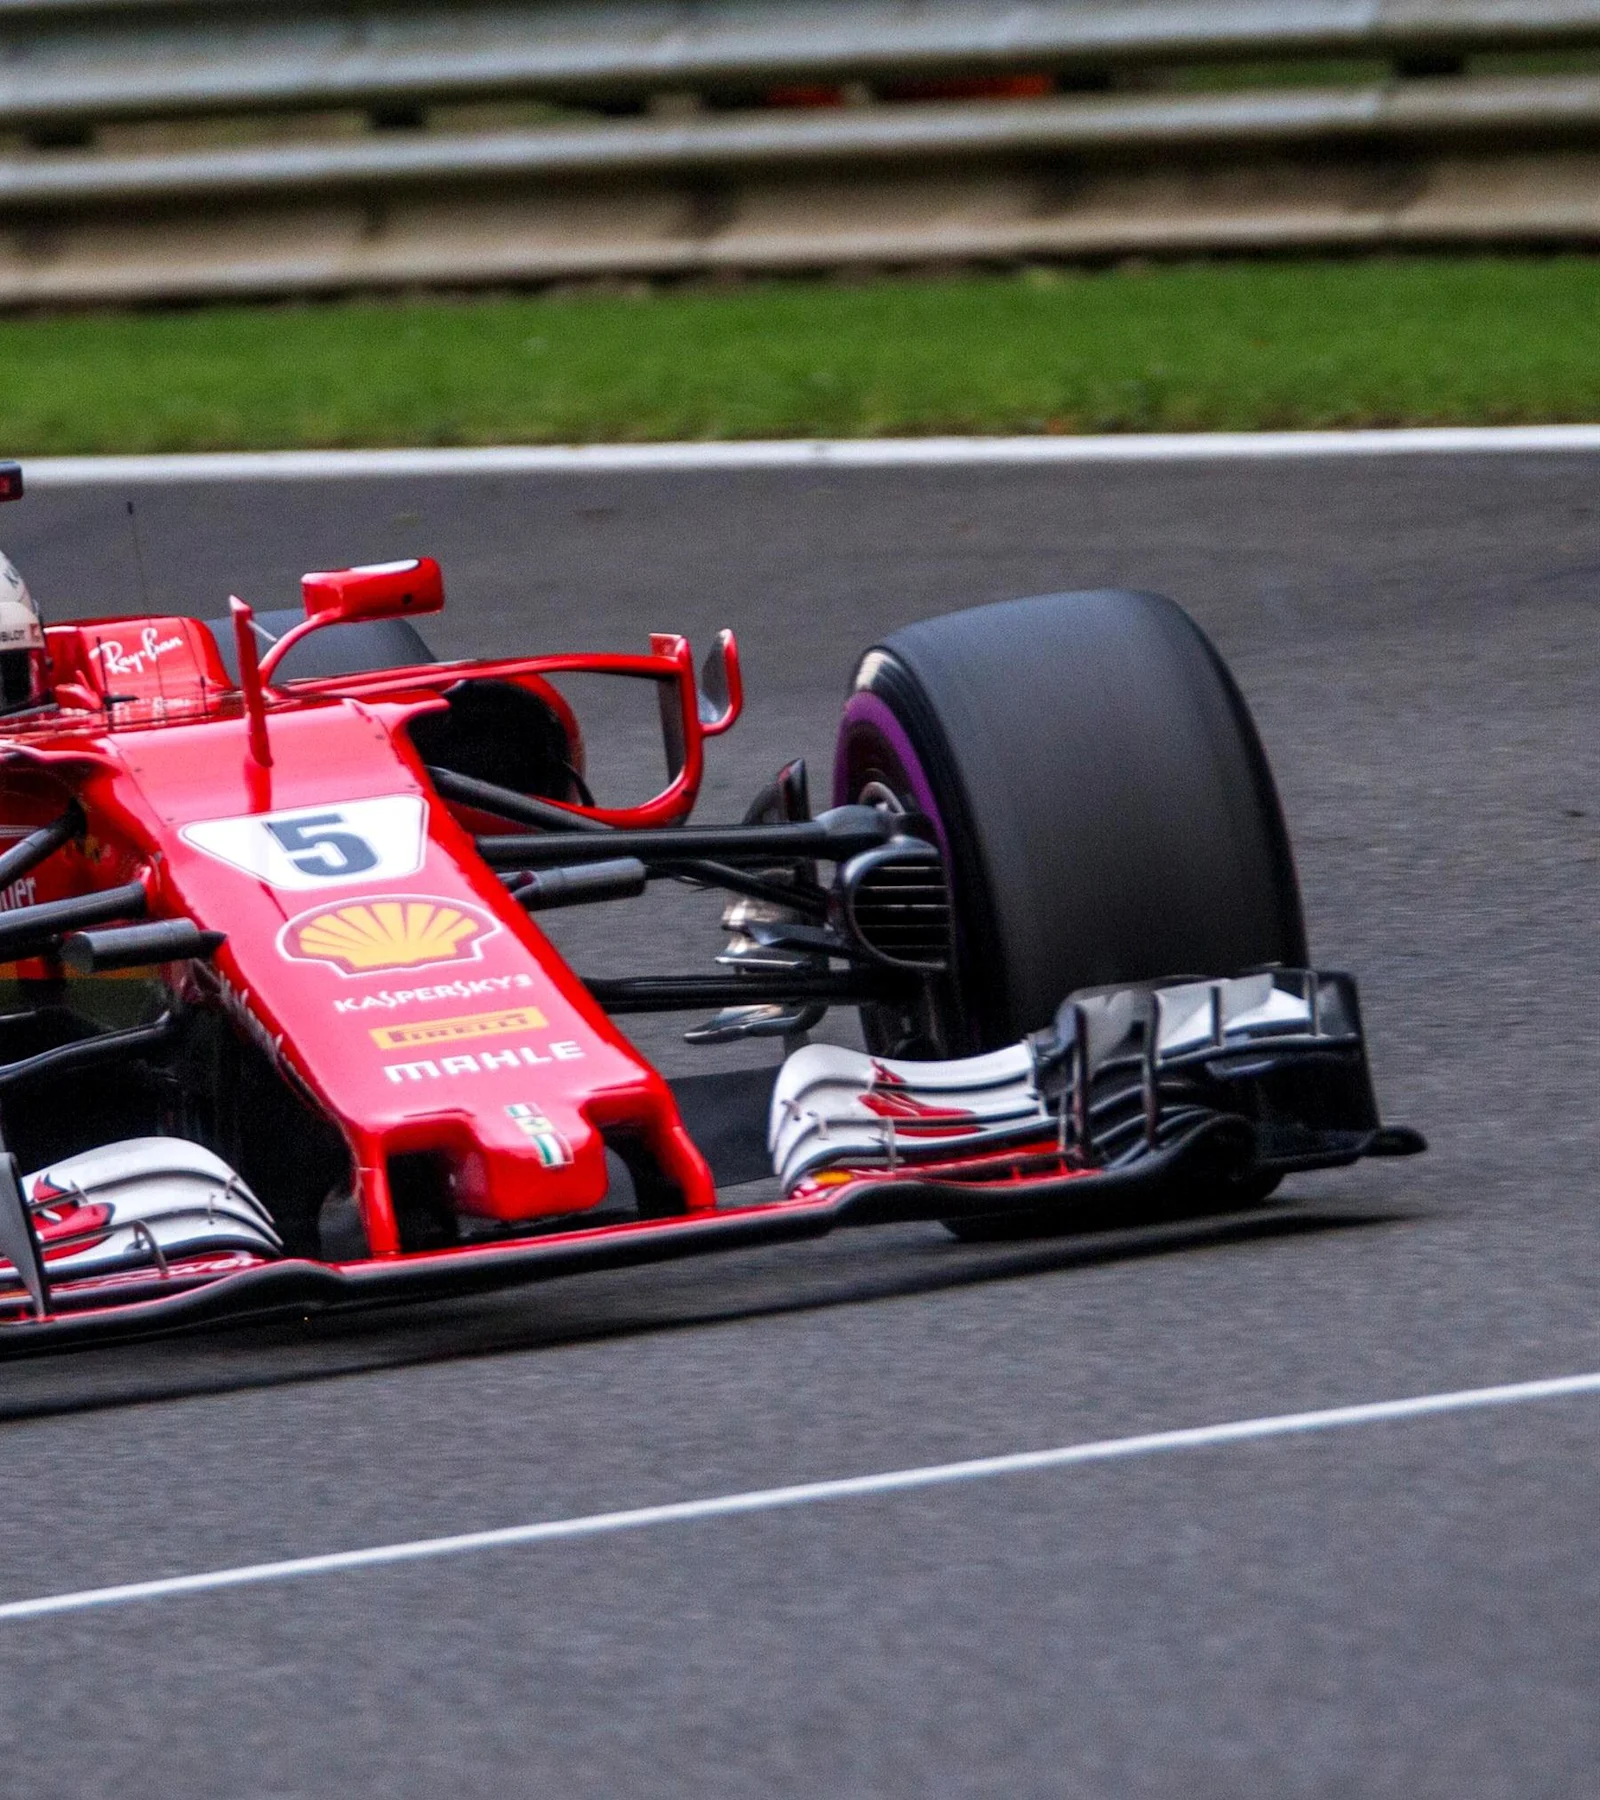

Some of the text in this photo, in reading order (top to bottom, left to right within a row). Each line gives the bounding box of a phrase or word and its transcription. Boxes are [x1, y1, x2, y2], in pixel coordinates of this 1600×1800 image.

[88, 627, 184, 674] Ray-Ban
[263, 812, 379, 877] 5
[334, 975, 512, 1013] KASPERSKY
[386, 1012, 529, 1044] PIRELLI
[383, 1040, 587, 1085] MAHLE
